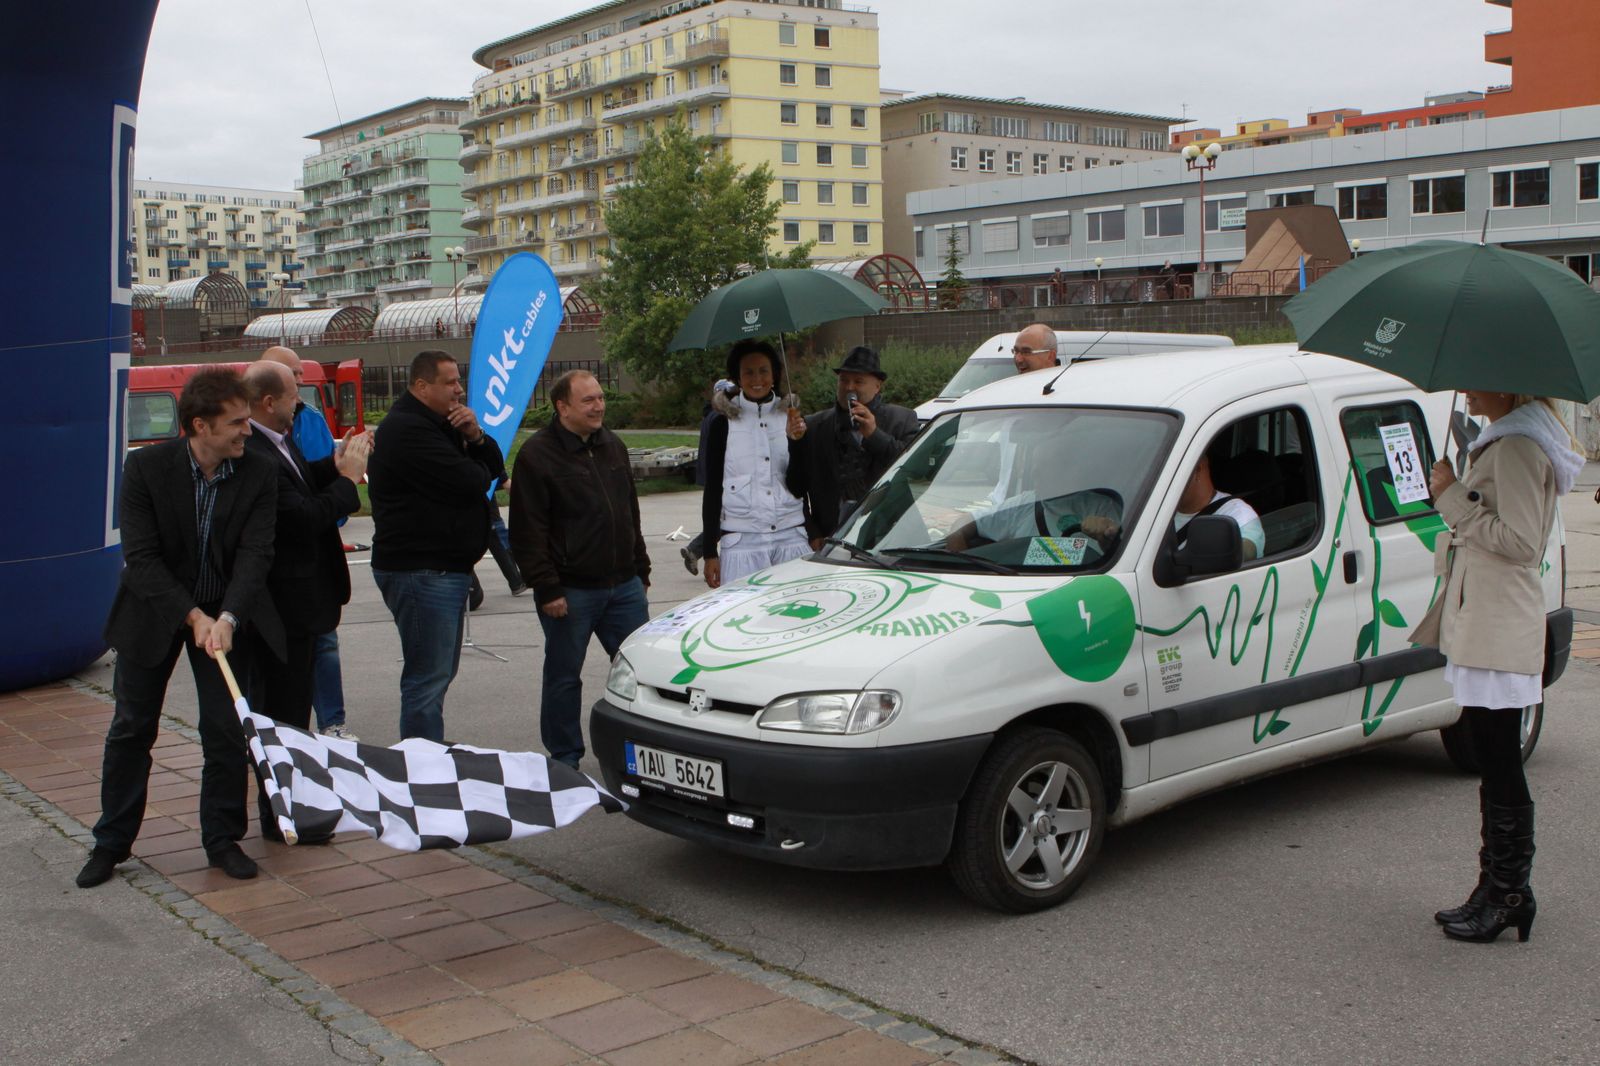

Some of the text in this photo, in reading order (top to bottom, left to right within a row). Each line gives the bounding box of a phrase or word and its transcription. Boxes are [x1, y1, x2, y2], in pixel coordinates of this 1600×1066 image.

[485, 290, 548, 411] nkt cables
[1394, 450, 1413, 475] 13
[1160, 662, 1183, 676] group
[627, 762, 637, 772] CZ
[638, 749, 716, 792] 1AU 5642
